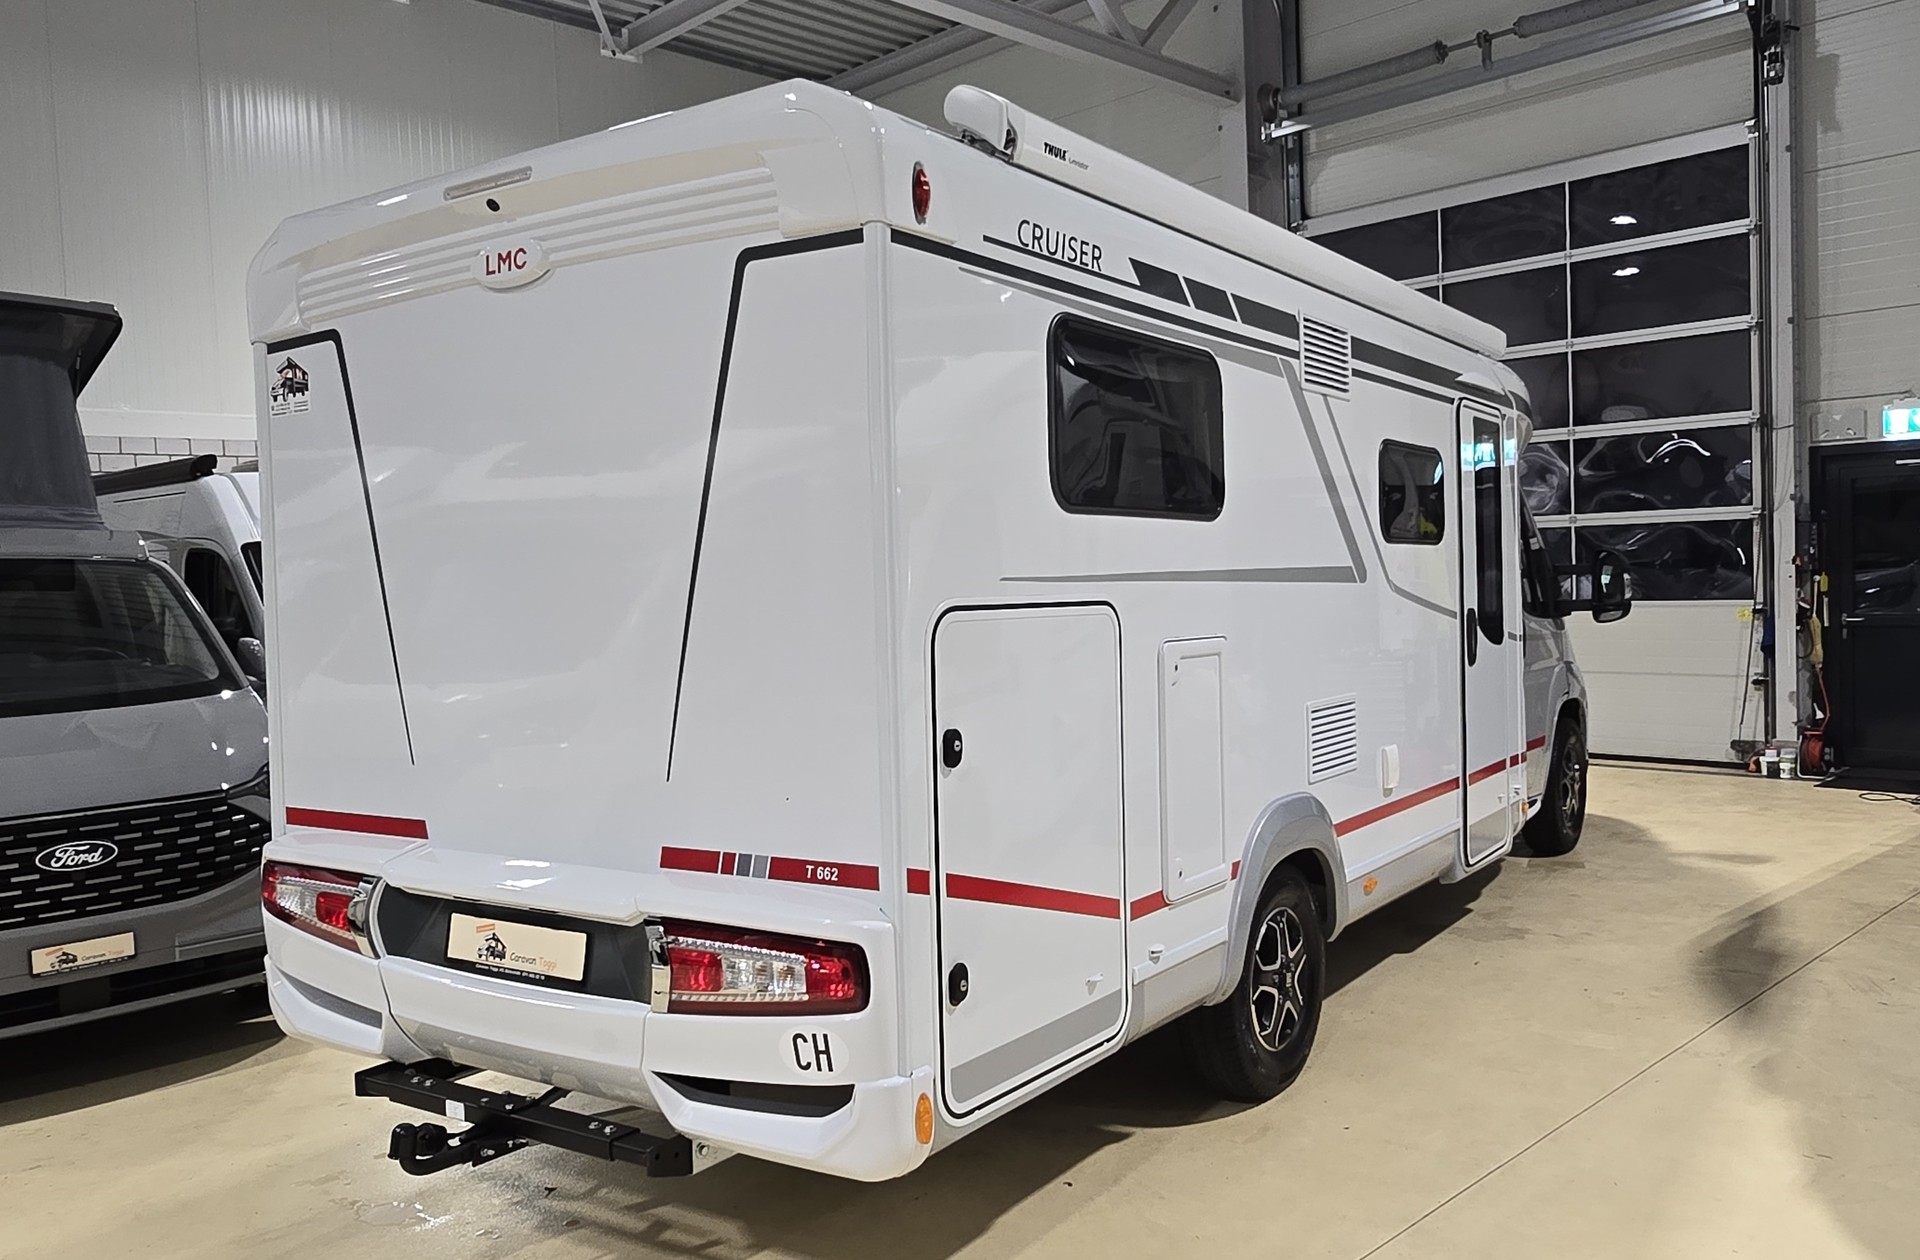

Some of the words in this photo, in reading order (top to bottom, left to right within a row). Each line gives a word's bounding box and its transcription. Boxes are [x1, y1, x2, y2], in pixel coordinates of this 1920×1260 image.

[1043, 141, 1067, 161] THULE
[1017, 219, 1102, 272] CRUISER
[486, 247, 527, 276] LMC
[50, 845, 103, 867] Ford
[805, 864, 815, 879] T
[816, 866, 839, 881] 662
[509, 952, 537, 966] Caravan
[539, 956, 557, 972] Toggi
[791, 1032, 834, 1073] CH
